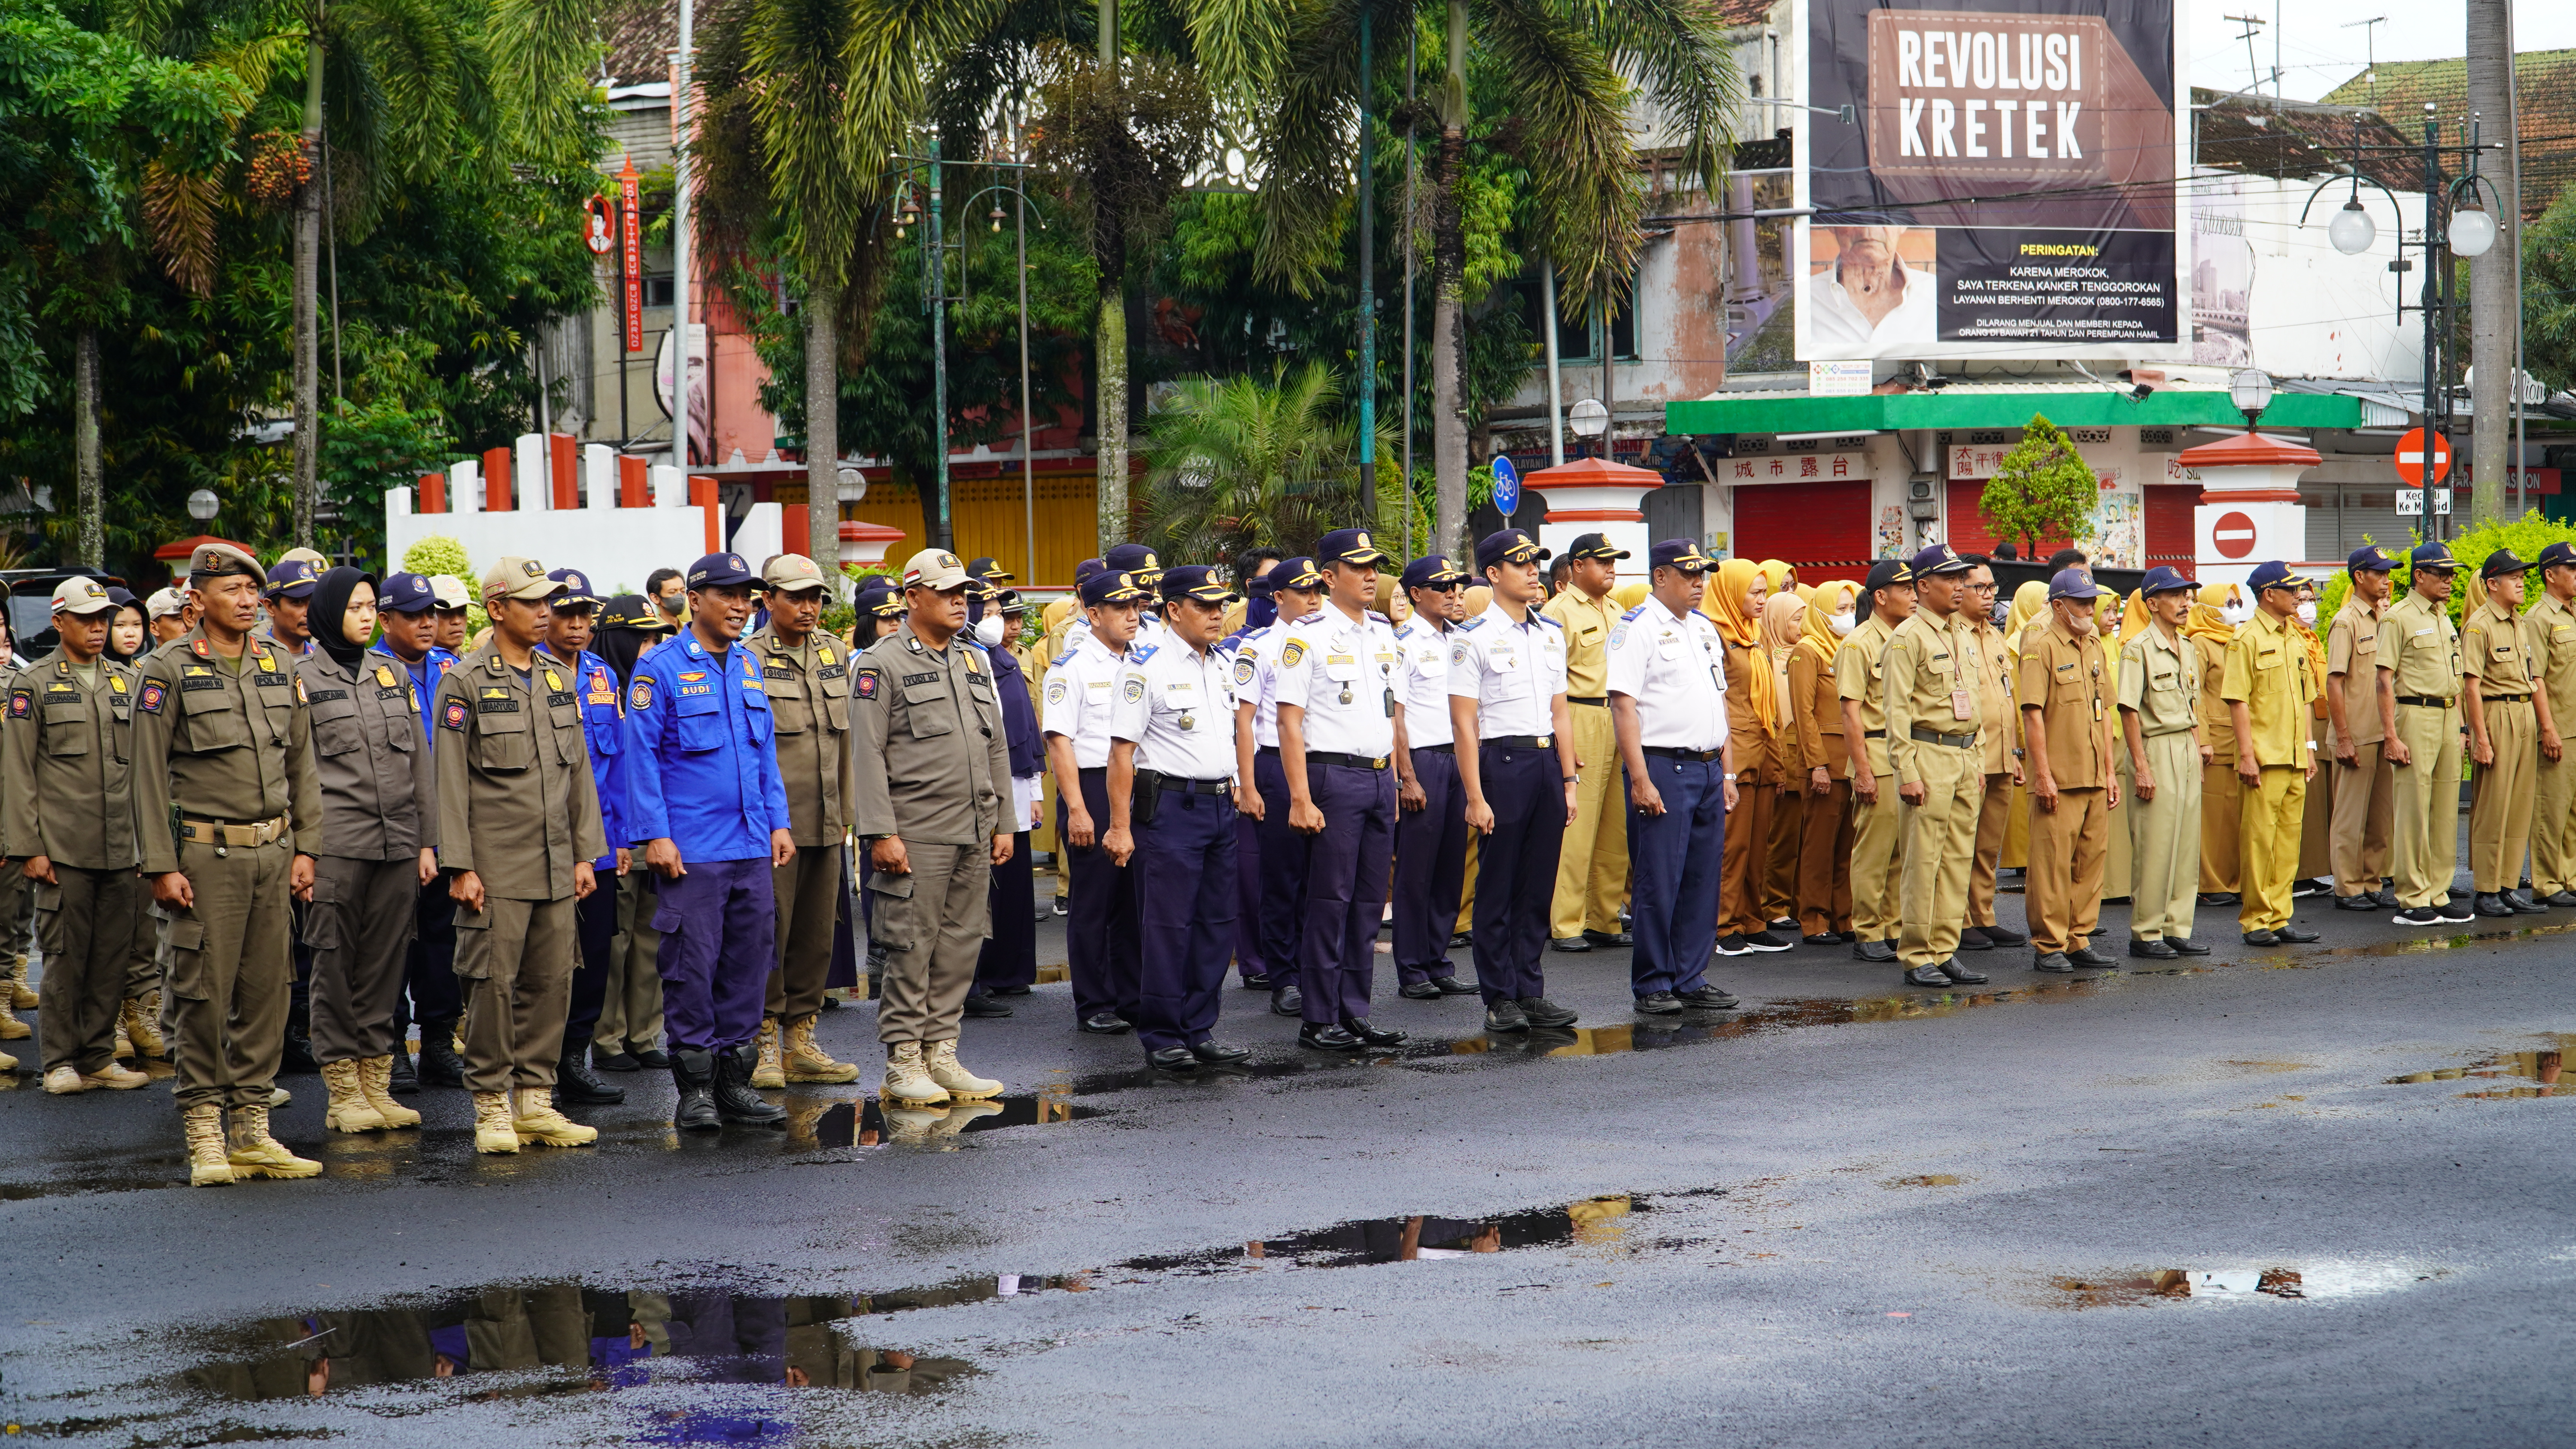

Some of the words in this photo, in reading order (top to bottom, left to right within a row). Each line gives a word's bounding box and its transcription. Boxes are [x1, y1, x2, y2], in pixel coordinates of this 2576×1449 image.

[1899, 30, 2081, 91] REVOLUSI
[1900, 98, 2082, 158] KRETEK
[2192, 186, 2211, 195] BLITAR
[2020, 245, 2099, 256] PERINGATAN:
[2010, 267, 2052, 277] KARENA
[2055, 267, 2109, 279] MEROKOK,
[1957, 280, 1984, 290] SAYA
[1985, 281, 2035, 291] TERKENA
[2036, 282, 2078, 291] KANKER
[2081, 282, 2160, 292] TENGGOROKAN
[629, 284, 638, 311] BUNG
[1954, 295, 1995, 304] LAYANAN
[1998, 296, 2045, 305] BERHENTI
[2047, 297, 2095, 306] MEROKOK
[2097, 297, 2165, 308] (0800-177-6565)
[1976, 319, 2016, 327] DILARANG
[2019, 319, 2054, 327] MENJUAL
[2075, 320, 2110, 328] MEMBERI
[2112, 321, 2143, 329] KEPADA
[630, 313, 639, 347] KARNO
[1959, 329, 1988, 337] ORANG
[2041, 329, 2066, 337] TAHUN
[2137, 330, 2160, 339] HAMIL
[1734, 455, 1848, 478] 城市露台
[2406, 491, 2439, 500] Kecli
[2399, 502, 2410, 512] Ke
[2415, 501, 2447, 513] Mjid
[2260, 580, 2277, 588] KORPRI
[182, 680, 213, 688] BAMBANG
[905, 675, 925, 684] YUDI
[968, 675, 979, 683] POL
[378, 690, 396, 698] POL
[682, 685, 710, 694] BUDI
[311, 691, 346, 701] NUR'AINI
[550, 696, 563, 704] POL
[483, 702, 515, 711] WAHYUDI
